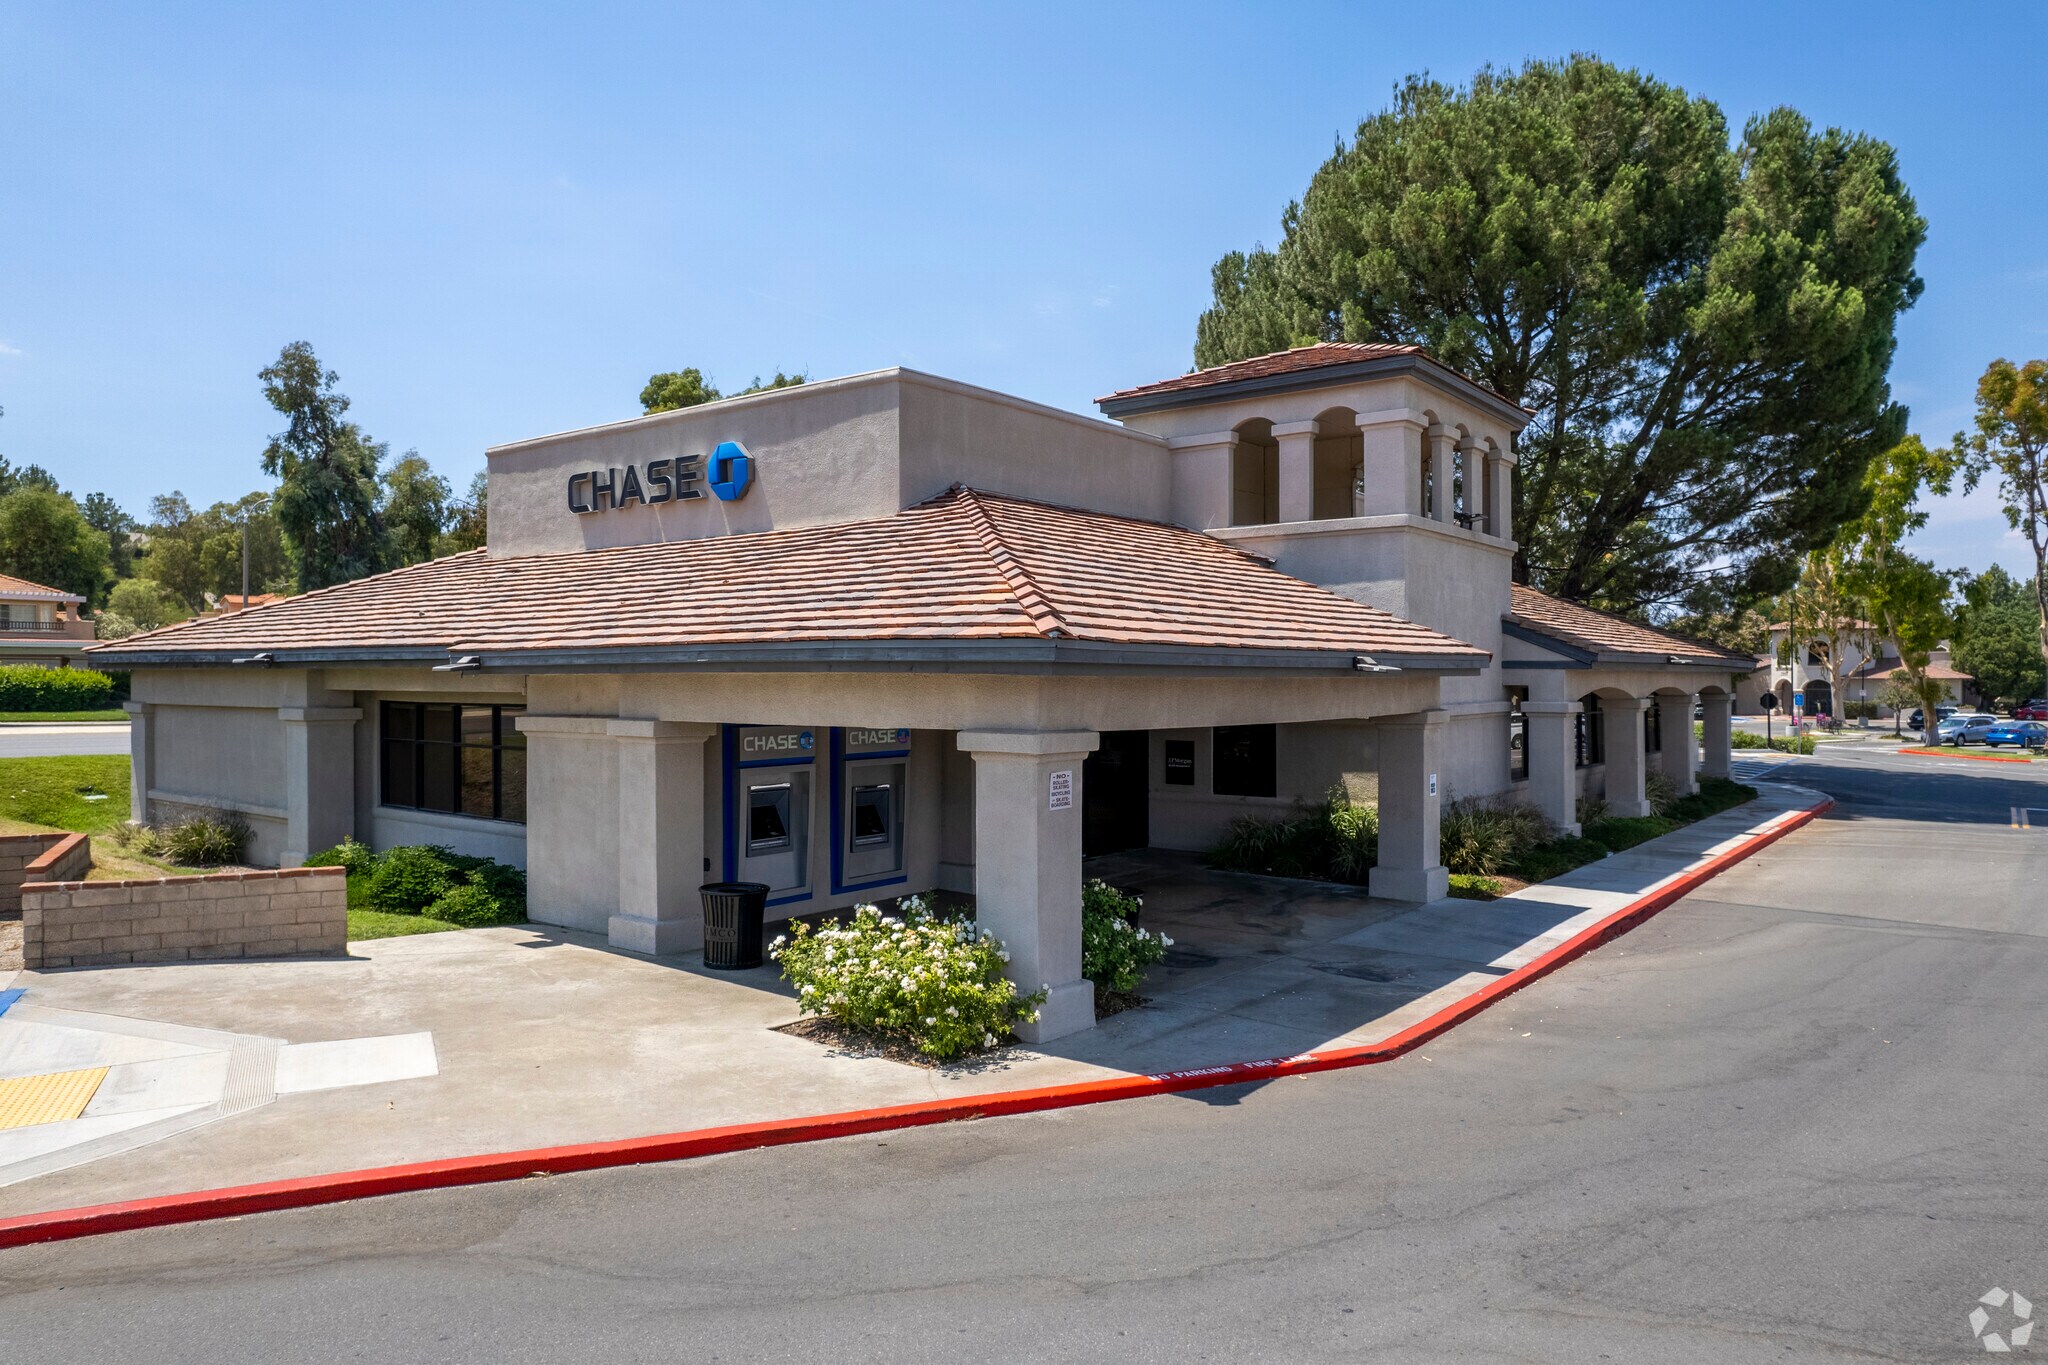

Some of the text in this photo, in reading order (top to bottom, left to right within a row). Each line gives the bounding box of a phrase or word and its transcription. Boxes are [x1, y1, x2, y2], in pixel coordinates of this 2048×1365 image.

[568, 454, 706, 514] CHASE
[743, 734, 798, 751] CHASE
[850, 729, 896, 745] CHASE
[1173, 1065, 1232, 1078] PARKING
[1243, 1059, 1279, 1069] FIRE
[1279, 1054, 1318, 1064] LANE
